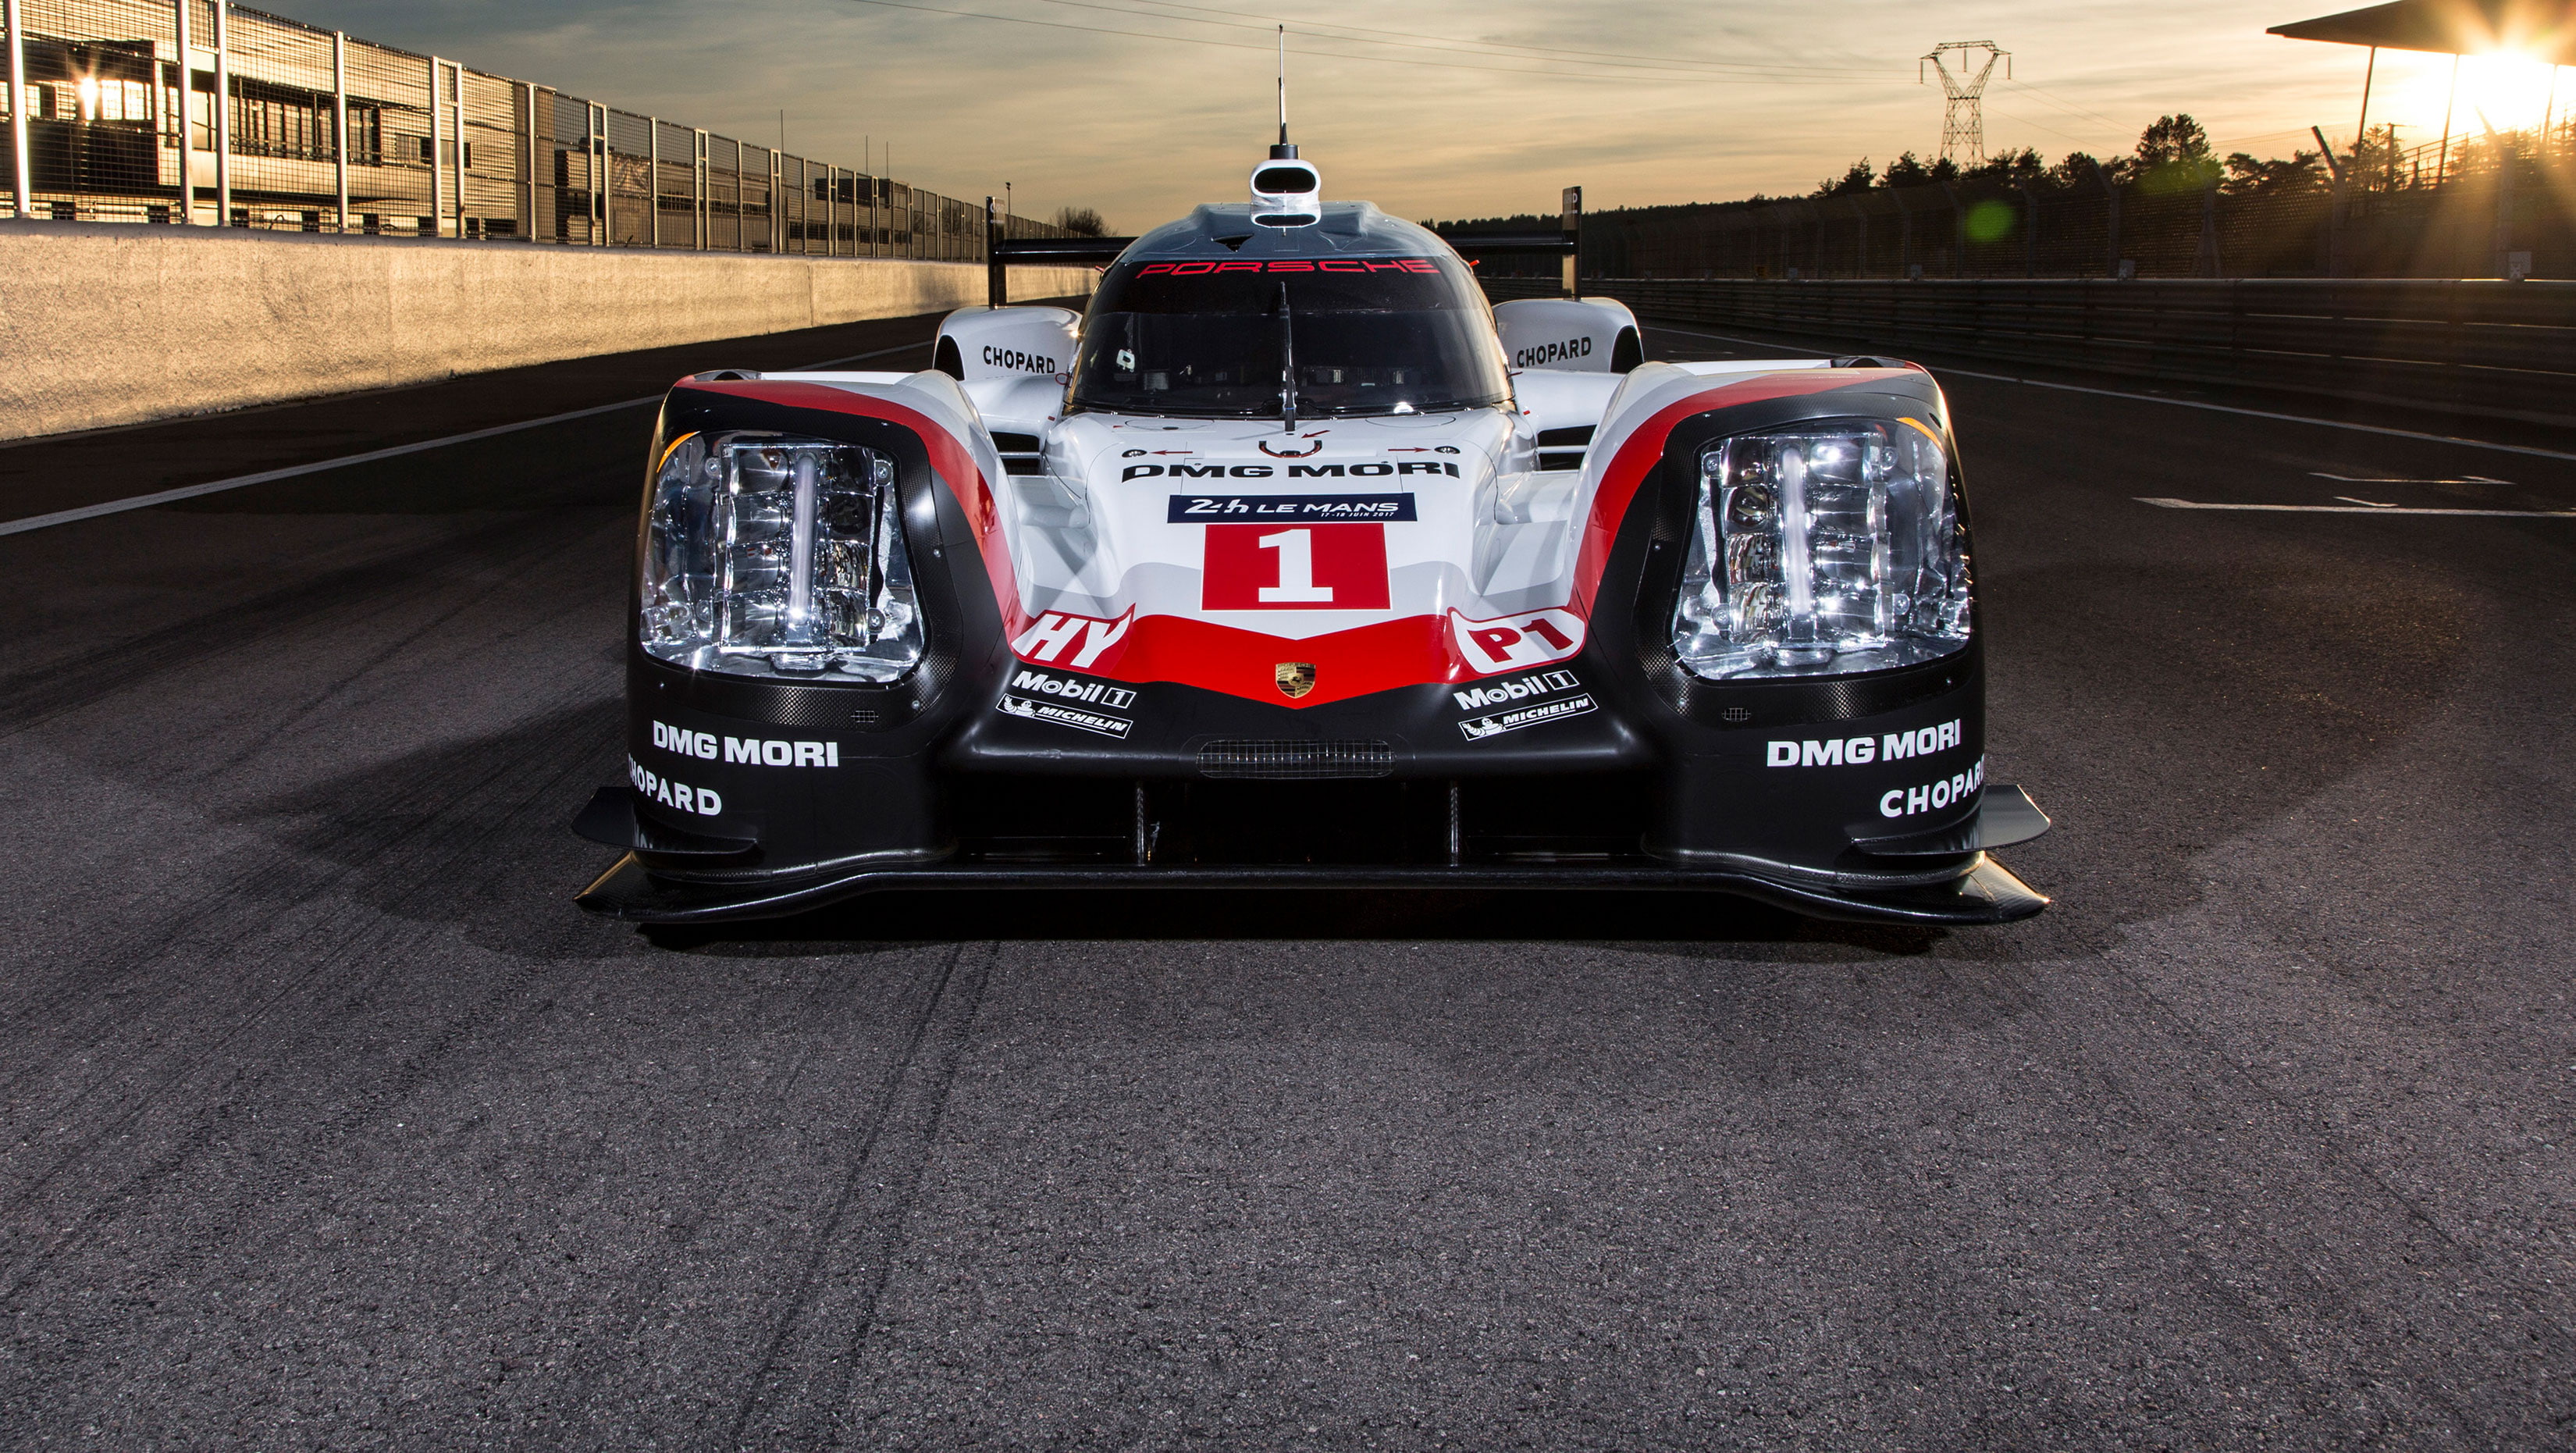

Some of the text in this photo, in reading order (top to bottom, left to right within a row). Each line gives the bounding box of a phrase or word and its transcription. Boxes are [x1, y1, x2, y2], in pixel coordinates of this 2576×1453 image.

[1136, 259, 1440, 279] PORSCHE
[984, 345, 1055, 374] CHOPARD
[1517, 337, 1592, 368] CHOPARD
[1122, 461, 1461, 483] DMG MORI
[1256, 504, 1298, 513] LE
[1303, 502, 1399, 512] MANS
[1258, 529, 1333, 602] 1
[1011, 613, 1132, 668] HY
[1467, 618, 1574, 664] P1
[1012, 670, 1105, 703] Mobil
[1453, 675, 1549, 710] Mobil
[1037, 706, 1128, 732] MICHELIN
[1503, 698, 1590, 725] MICHELIN
[653, 720, 838, 767] DMG MORI
[1767, 718, 1961, 767] DMG MORI
